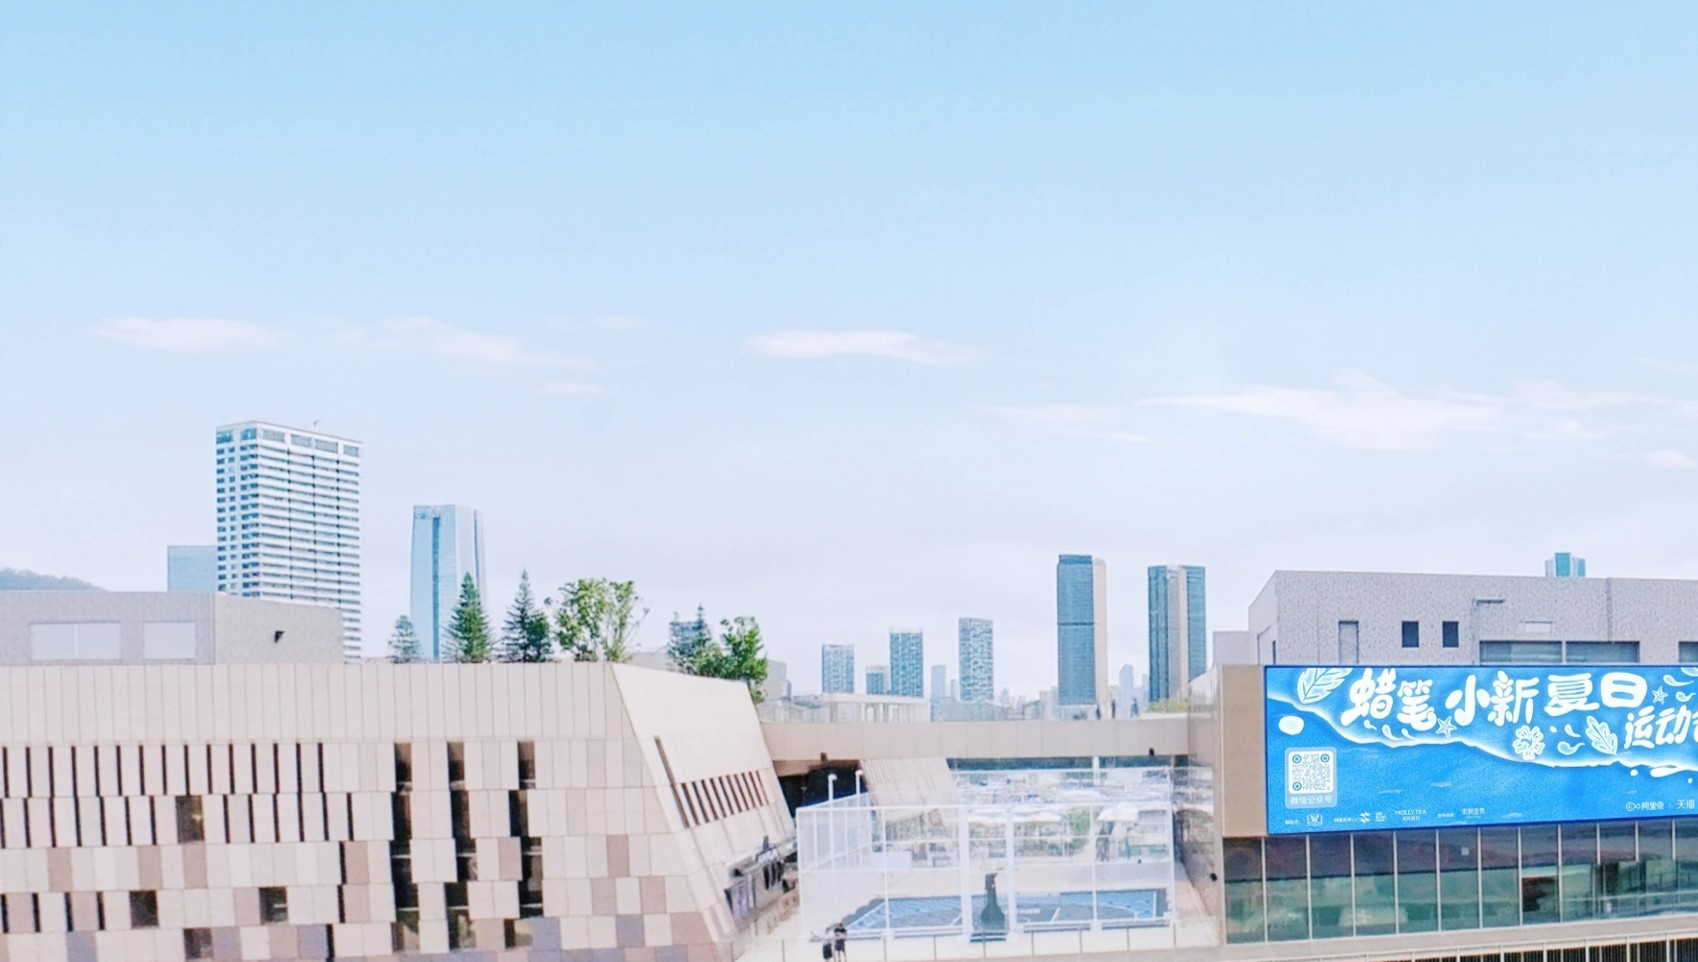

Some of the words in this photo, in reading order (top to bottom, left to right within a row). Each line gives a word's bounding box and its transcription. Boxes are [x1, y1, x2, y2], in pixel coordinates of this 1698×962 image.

[1340, 668, 1648, 731] 蜡笔小新夏日
